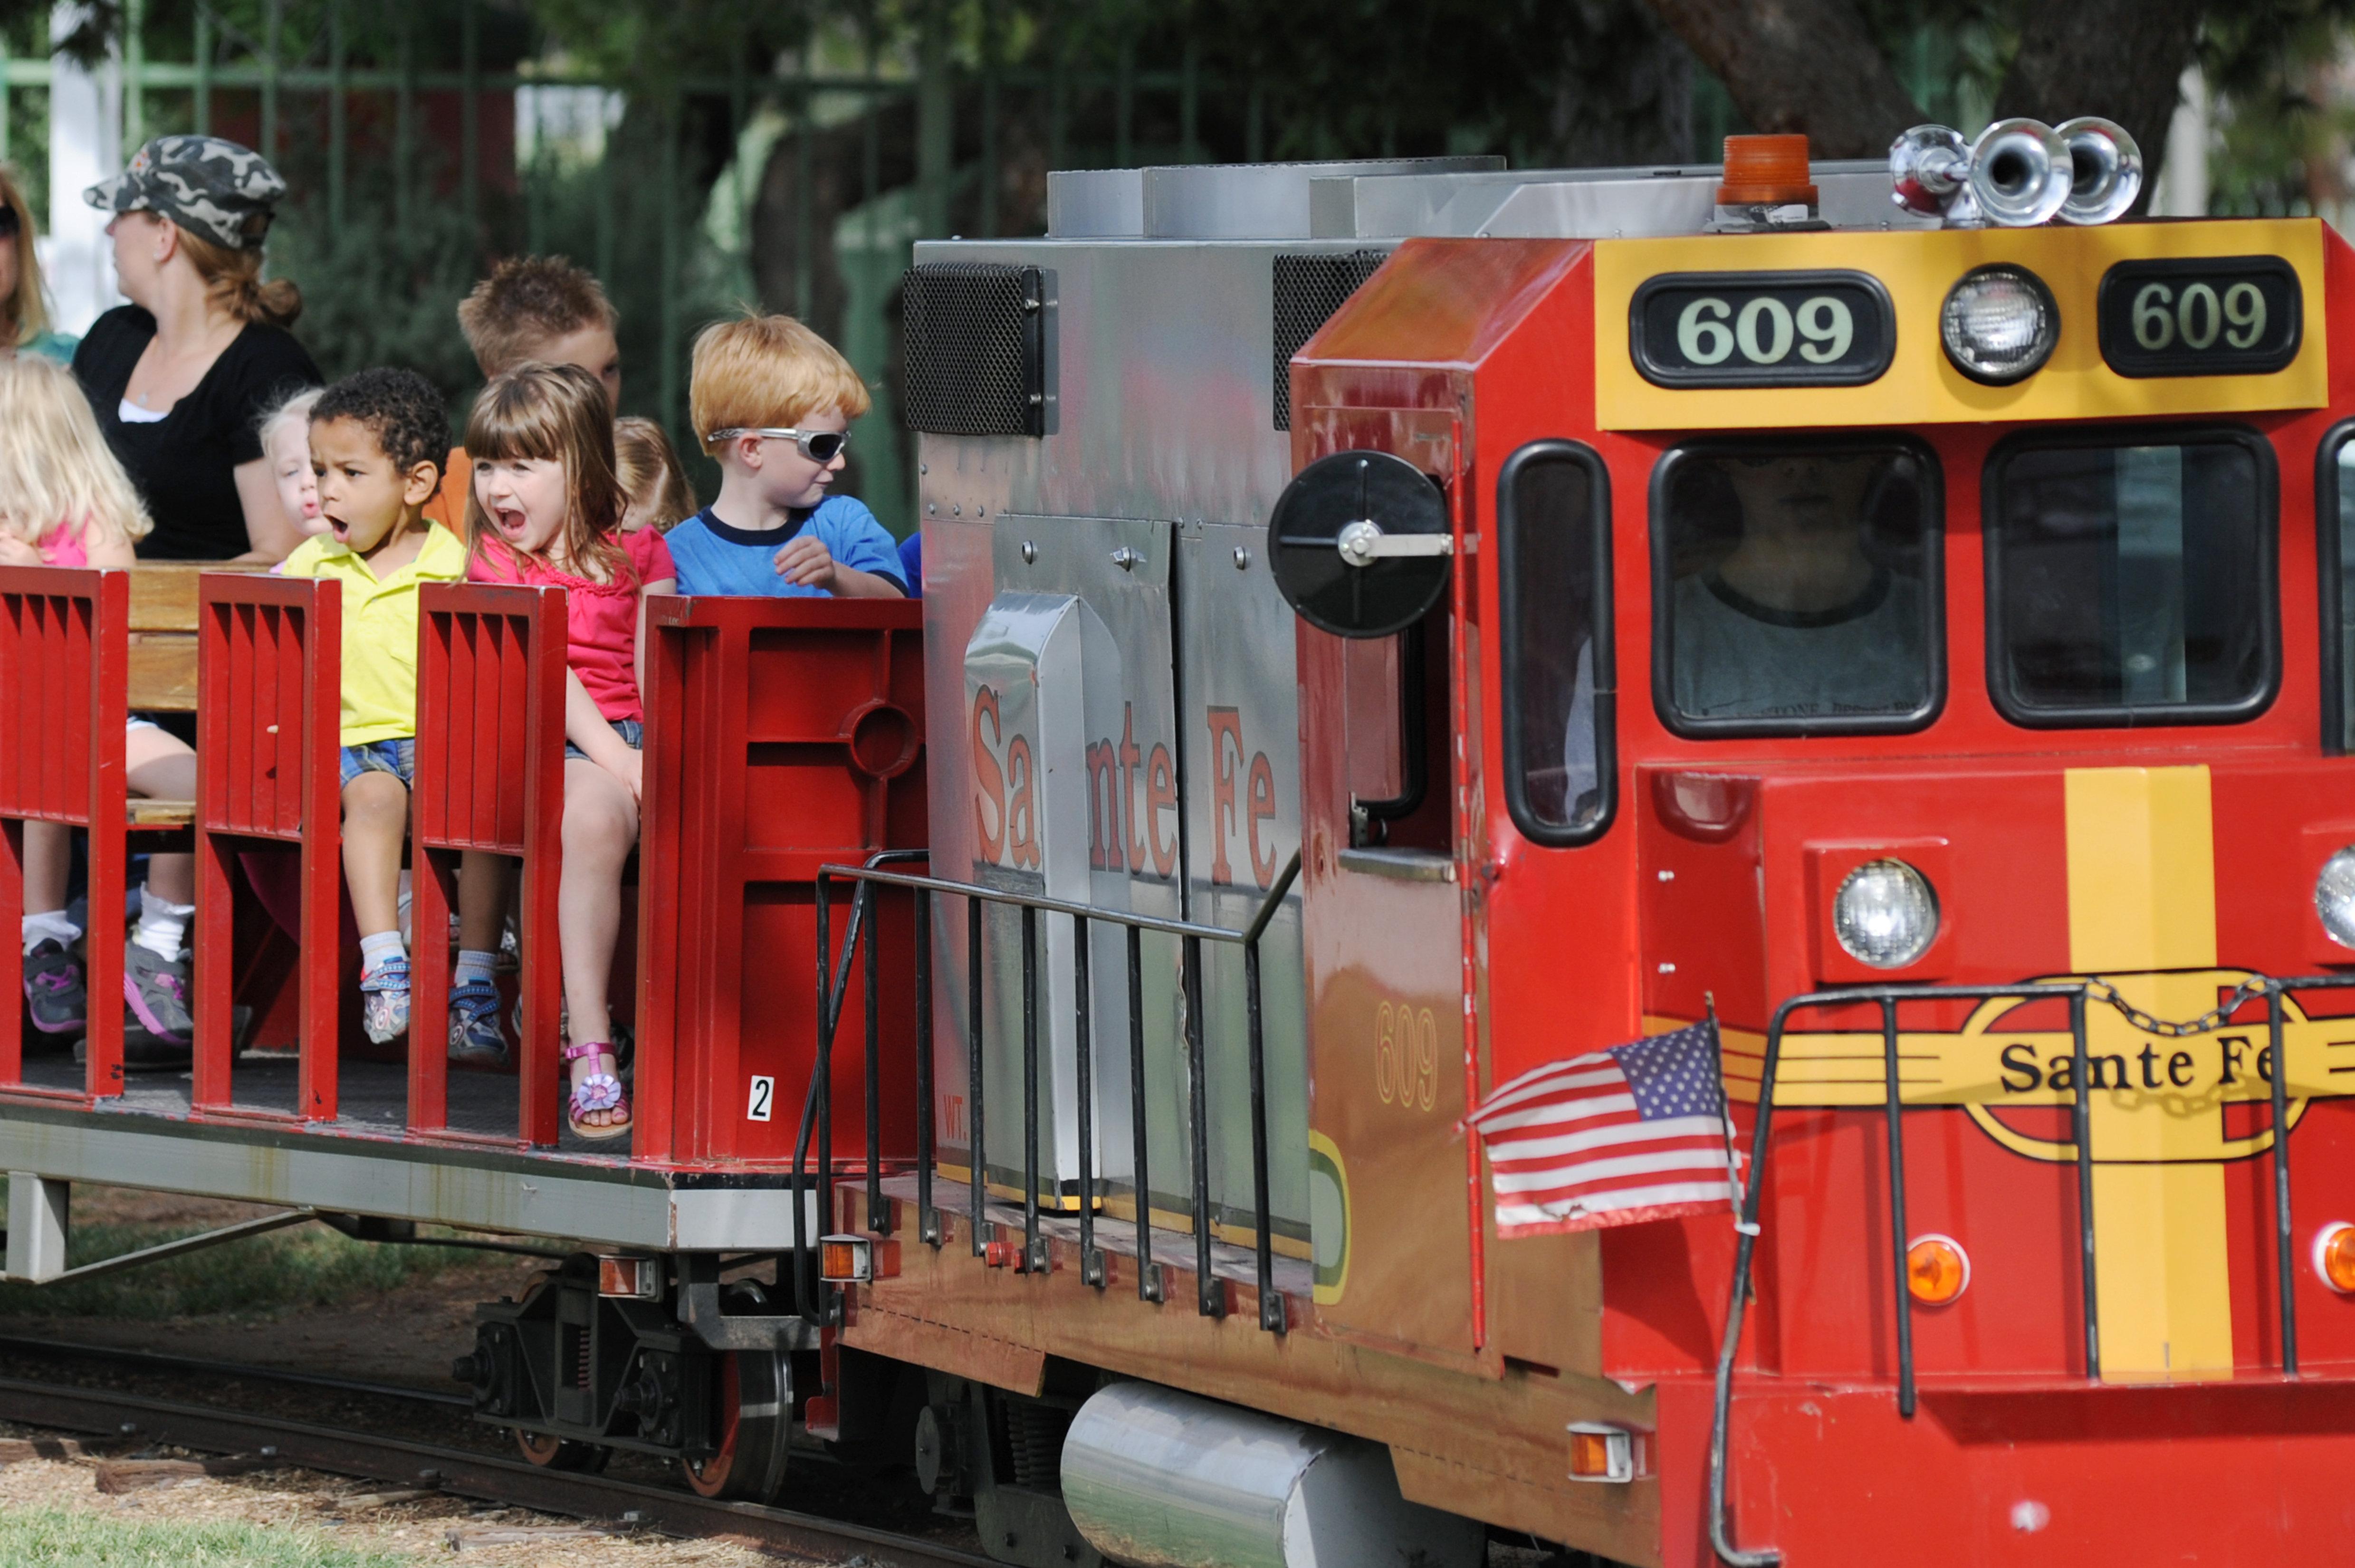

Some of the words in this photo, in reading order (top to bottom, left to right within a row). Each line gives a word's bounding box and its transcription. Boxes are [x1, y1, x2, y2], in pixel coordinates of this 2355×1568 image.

[1677, 296, 1853, 365] 609
[2132, 282, 2267, 350] 609
[973, 683, 1178, 880] Sante
[1206, 705, 1277, 892] Fe
[1376, 1000, 1438, 1112] 609
[2001, 1042, 2194, 1094] Sante
[753, 1079, 769, 1117] 2
